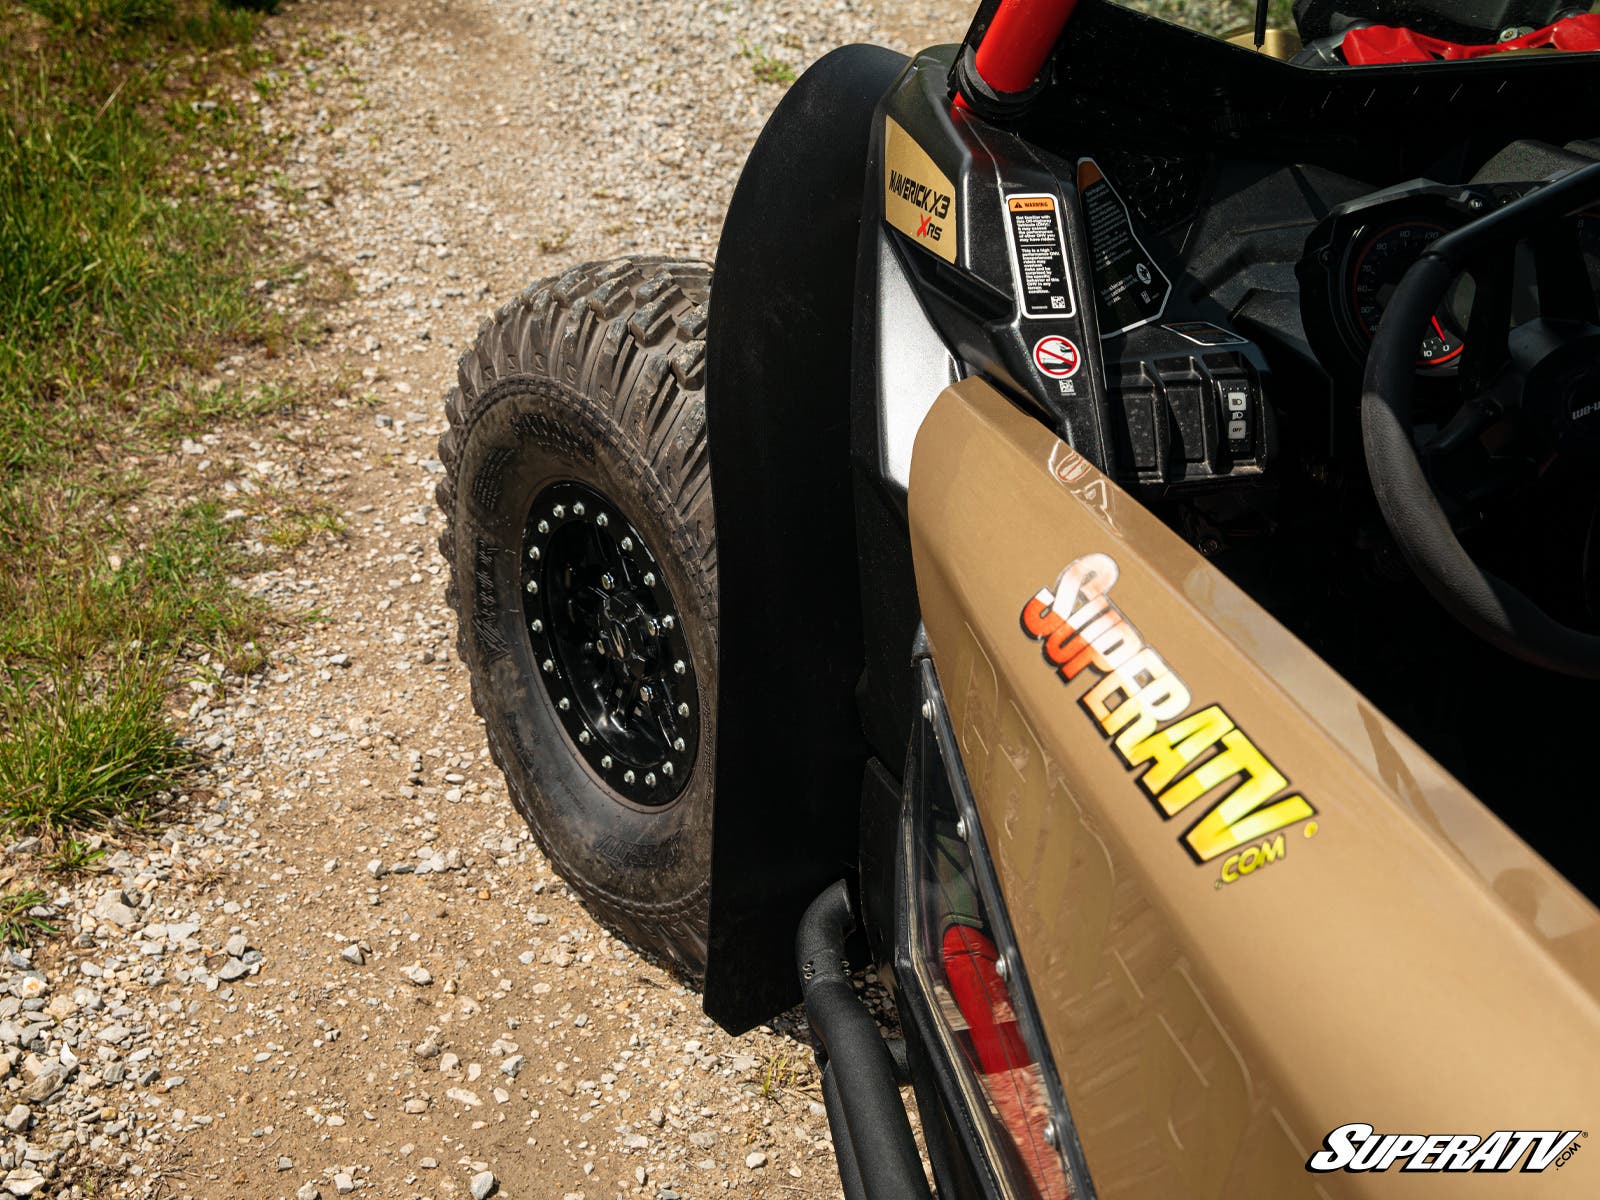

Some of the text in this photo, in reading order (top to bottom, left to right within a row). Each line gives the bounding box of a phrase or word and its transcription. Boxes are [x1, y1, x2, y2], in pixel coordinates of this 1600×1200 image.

[889, 170, 950, 220] MAVERICK X3
[1020, 552, 1318, 866] SUPERATV
